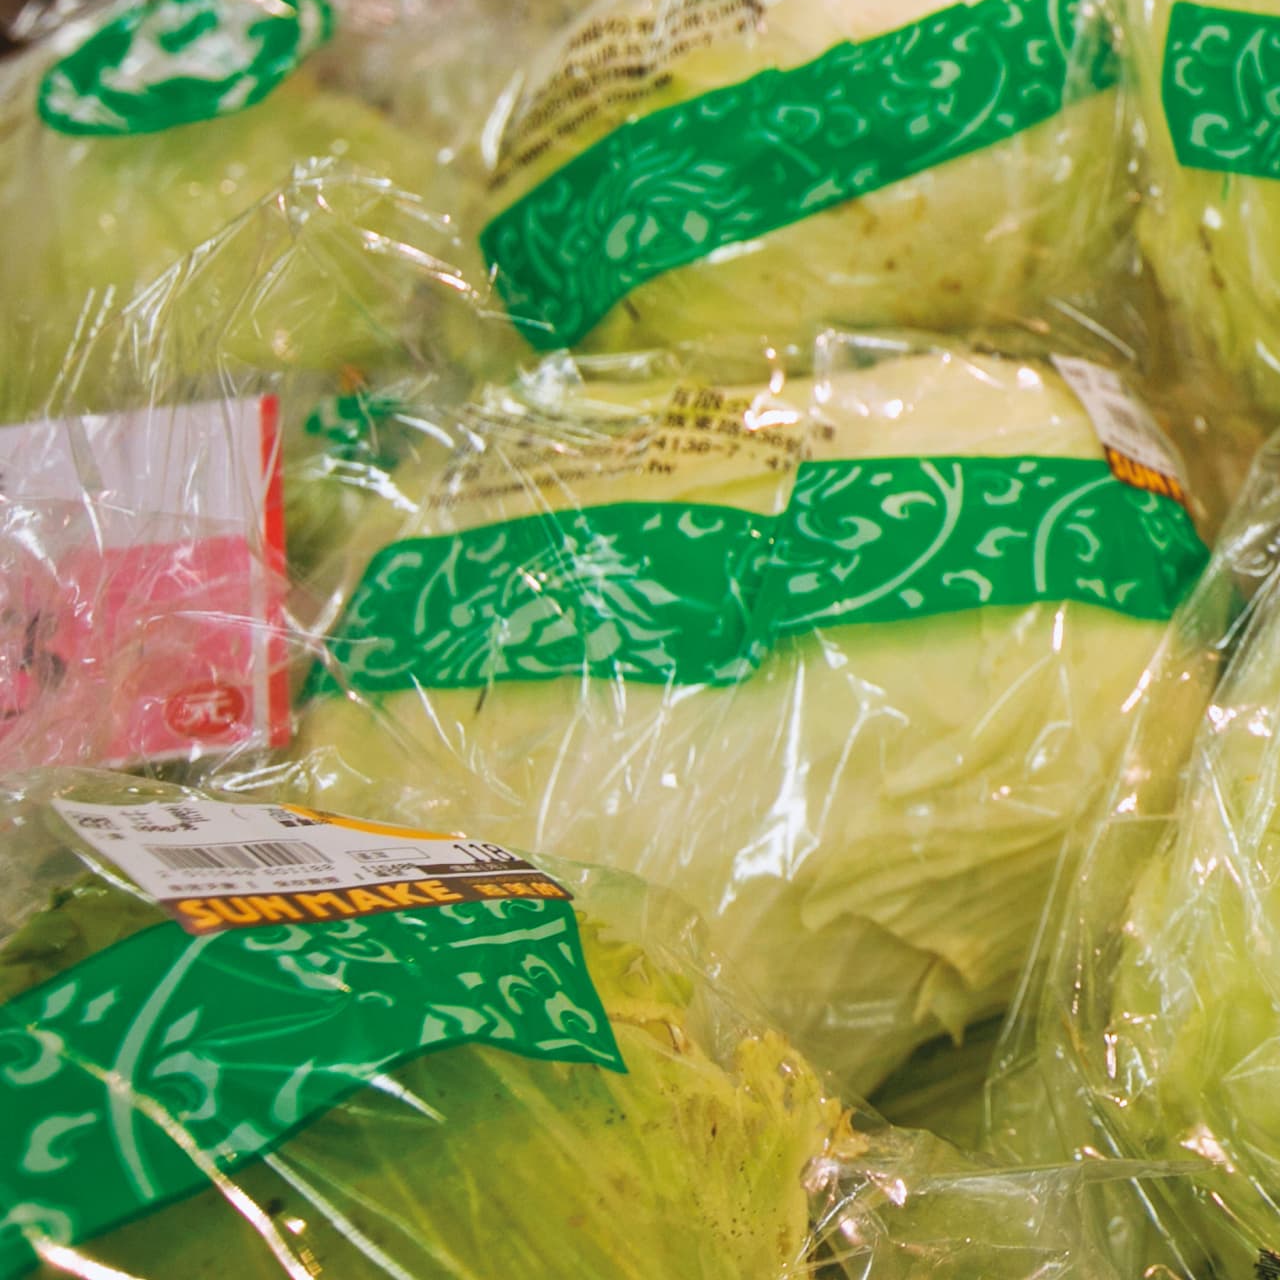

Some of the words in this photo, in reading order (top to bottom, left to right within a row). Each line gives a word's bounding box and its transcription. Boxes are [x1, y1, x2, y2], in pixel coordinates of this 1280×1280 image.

[452, 842, 516, 863] 118
[177, 894, 303, 929] SUN
[294, 879, 464, 919] MAKE
